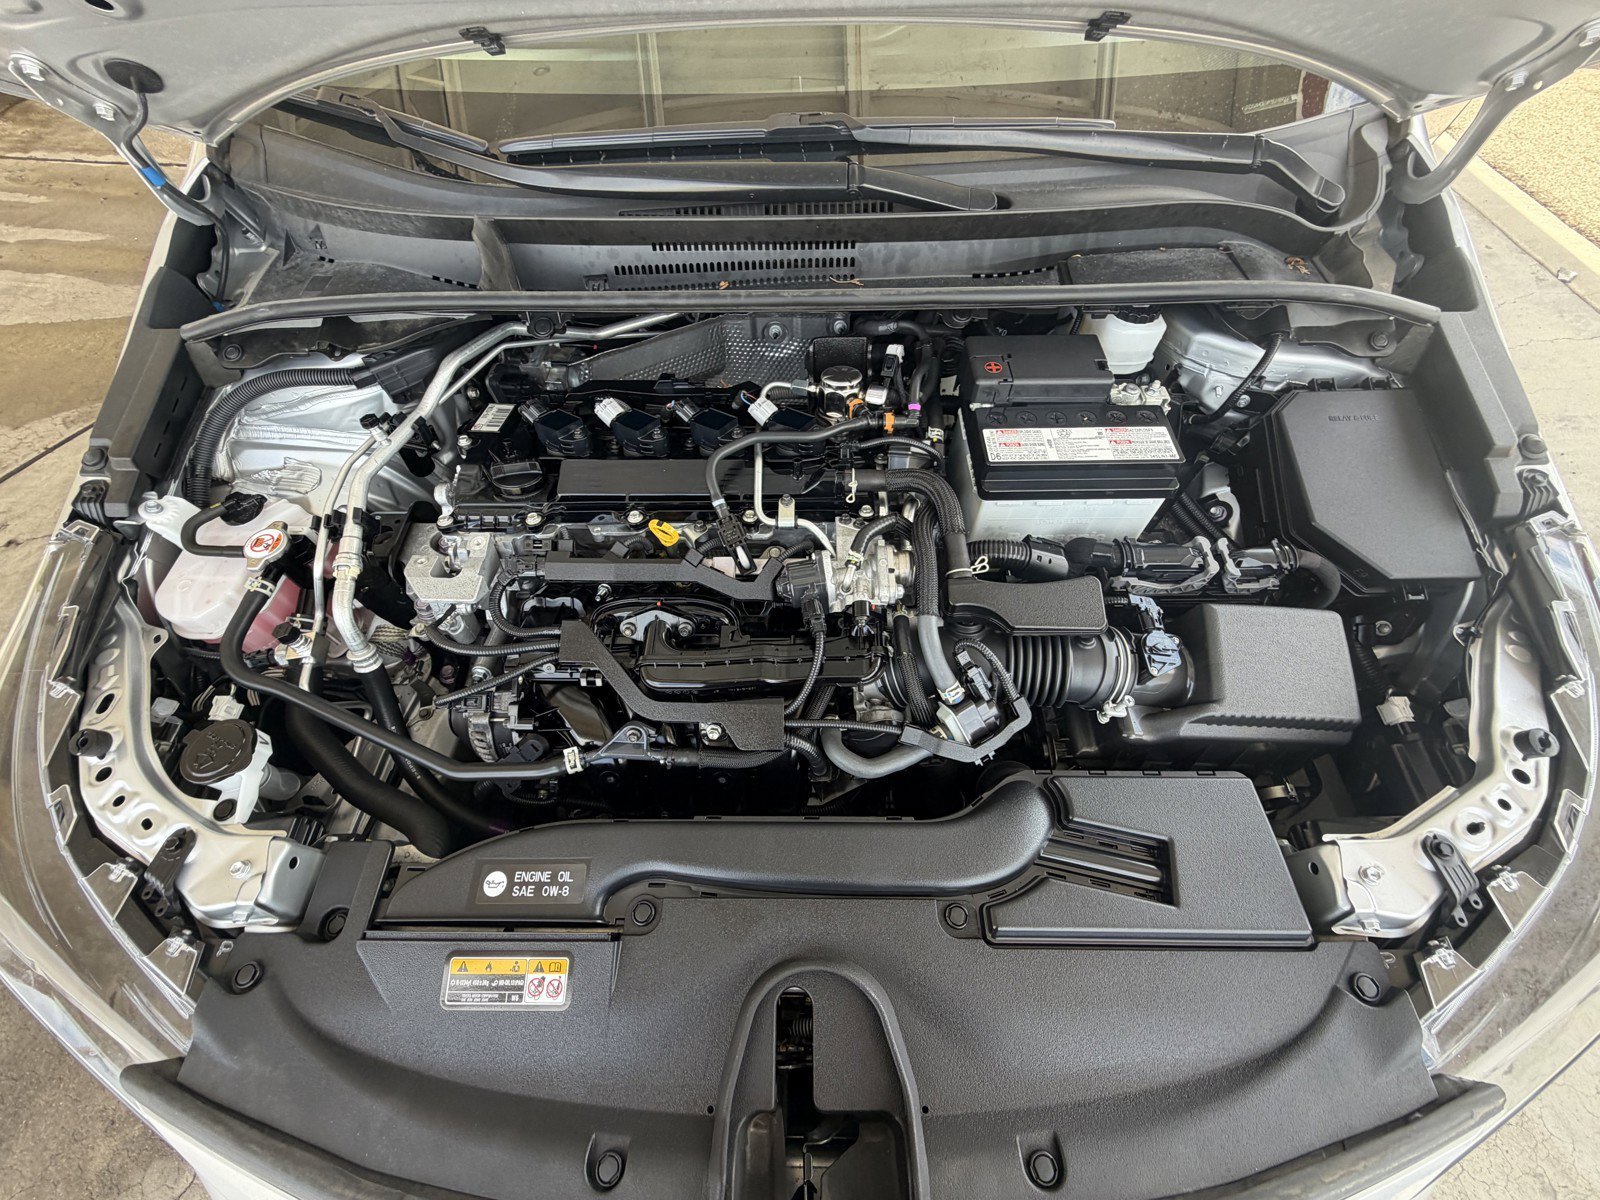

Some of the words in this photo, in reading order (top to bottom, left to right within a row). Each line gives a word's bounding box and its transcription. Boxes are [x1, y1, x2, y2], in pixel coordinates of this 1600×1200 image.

[990, 452, 1002, 460] D6
[514, 871, 552, 883] ENGINE
[558, 871, 574, 882] OIL
[511, 885, 535, 897] SAE
[542, 886, 570, 897] 0W-8
